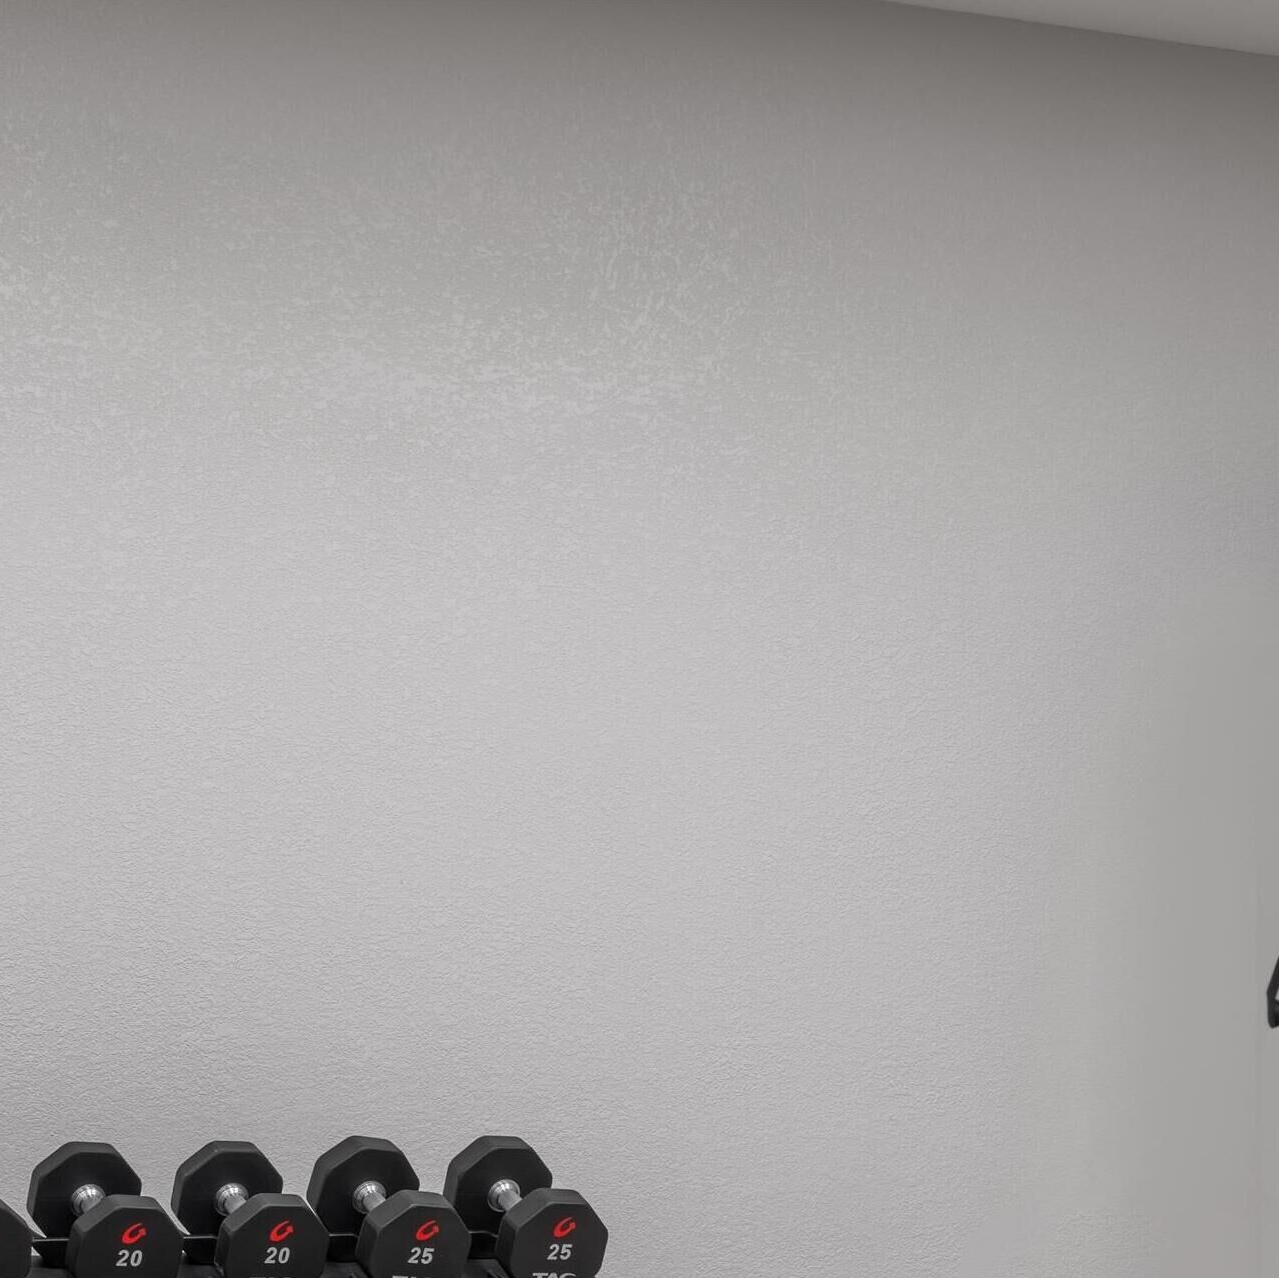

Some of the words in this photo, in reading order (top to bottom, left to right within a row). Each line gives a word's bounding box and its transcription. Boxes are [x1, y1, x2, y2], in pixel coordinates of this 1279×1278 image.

[115, 1249, 143, 1267] 20
[263, 1246, 291, 1264] 20
[406, 1246, 435, 1265] 25
[546, 1243, 573, 1261] 25
